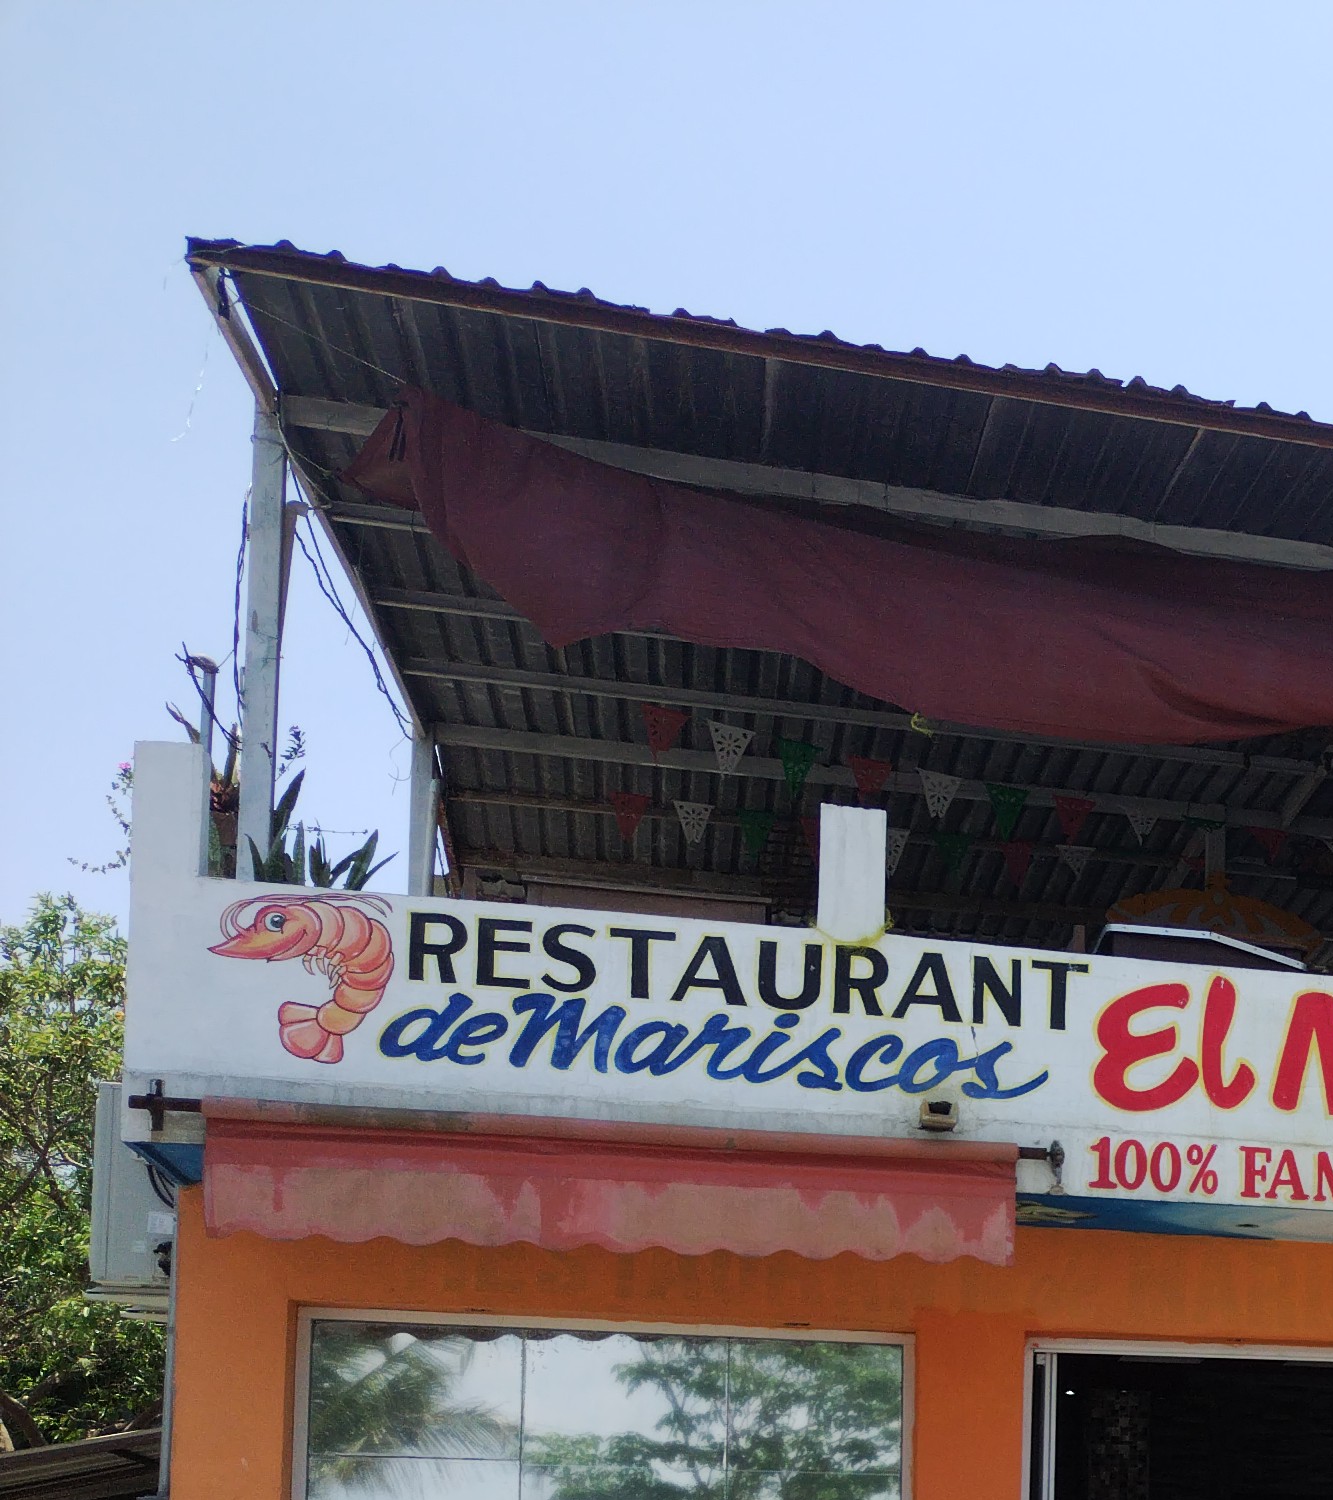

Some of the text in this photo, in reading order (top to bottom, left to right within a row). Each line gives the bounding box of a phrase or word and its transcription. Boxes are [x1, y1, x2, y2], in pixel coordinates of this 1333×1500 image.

[408, 911, 1090, 1031] RESTAURANT
[1094, 974, 1257, 1112] El
[1089, 1136, 1219, 1195] 100%
